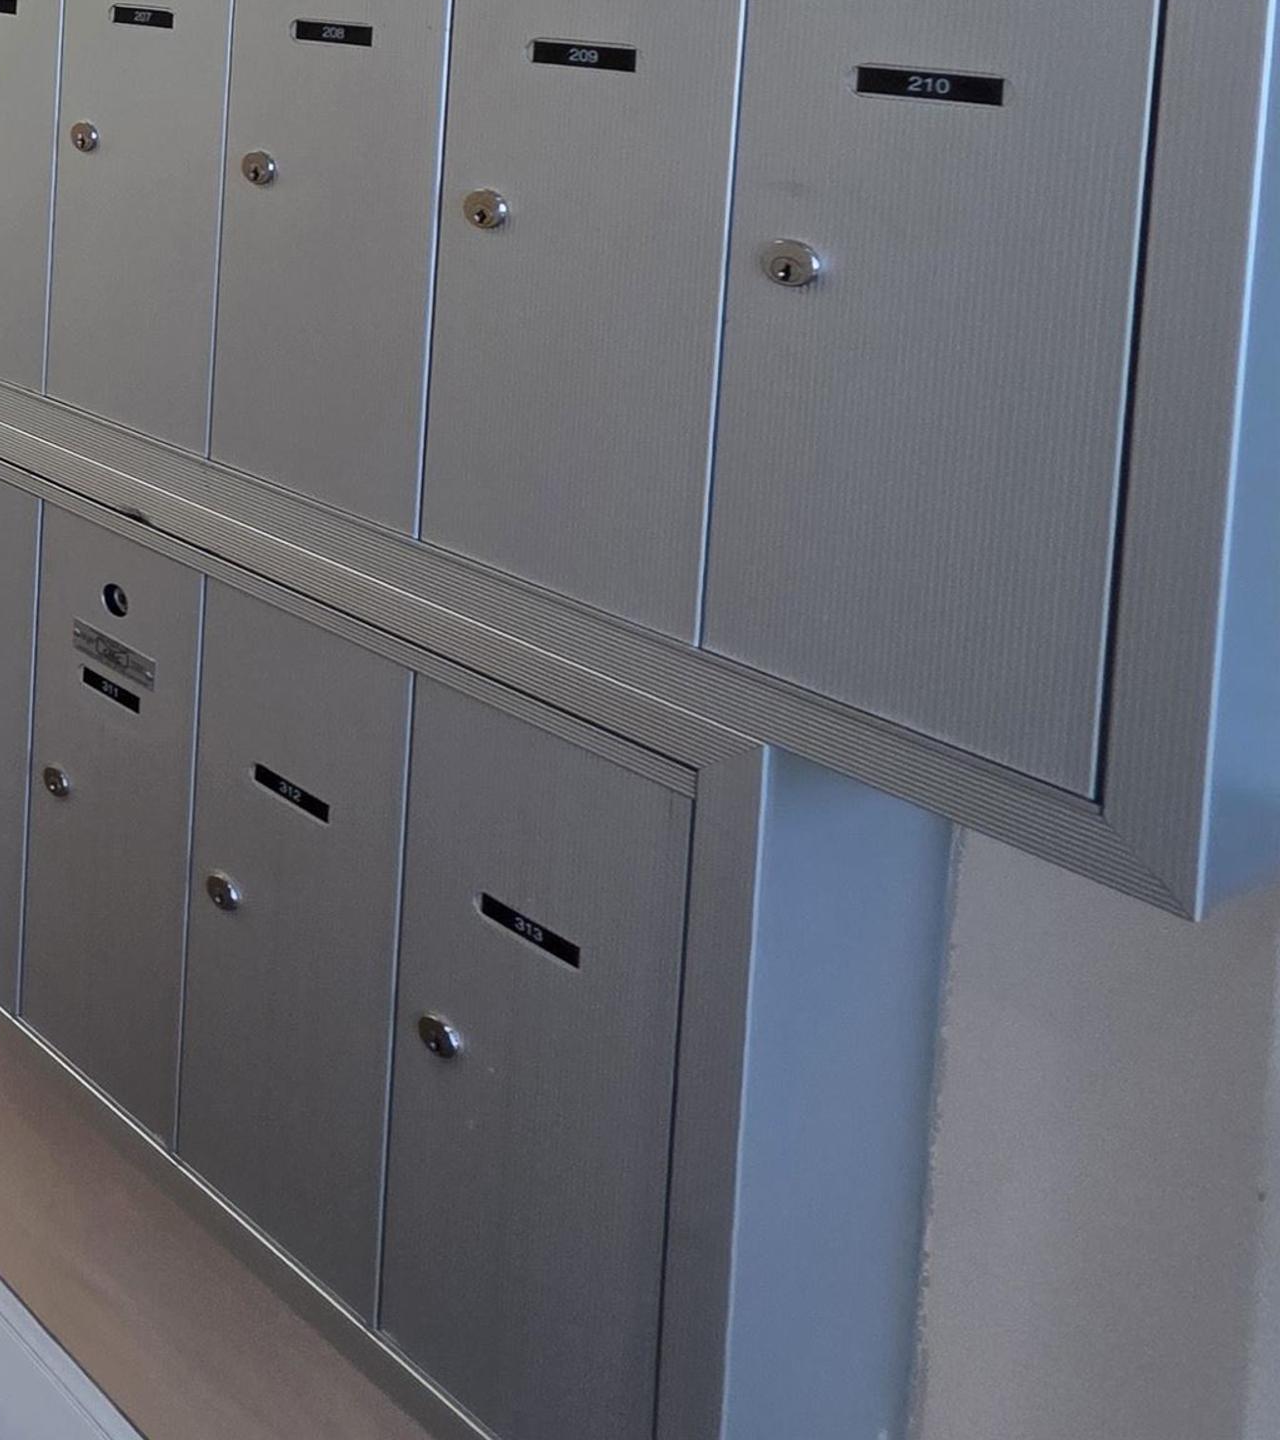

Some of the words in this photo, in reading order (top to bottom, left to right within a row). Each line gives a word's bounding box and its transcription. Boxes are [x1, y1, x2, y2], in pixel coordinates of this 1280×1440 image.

[133, 10, 152, 22] 207
[321, 25, 345, 39] 208
[568, 47, 599, 63] 209
[907, 75, 951, 94] 210
[101, 680, 119, 697] 311
[279, 780, 302, 802] 312
[514, 916, 543, 942] 313
